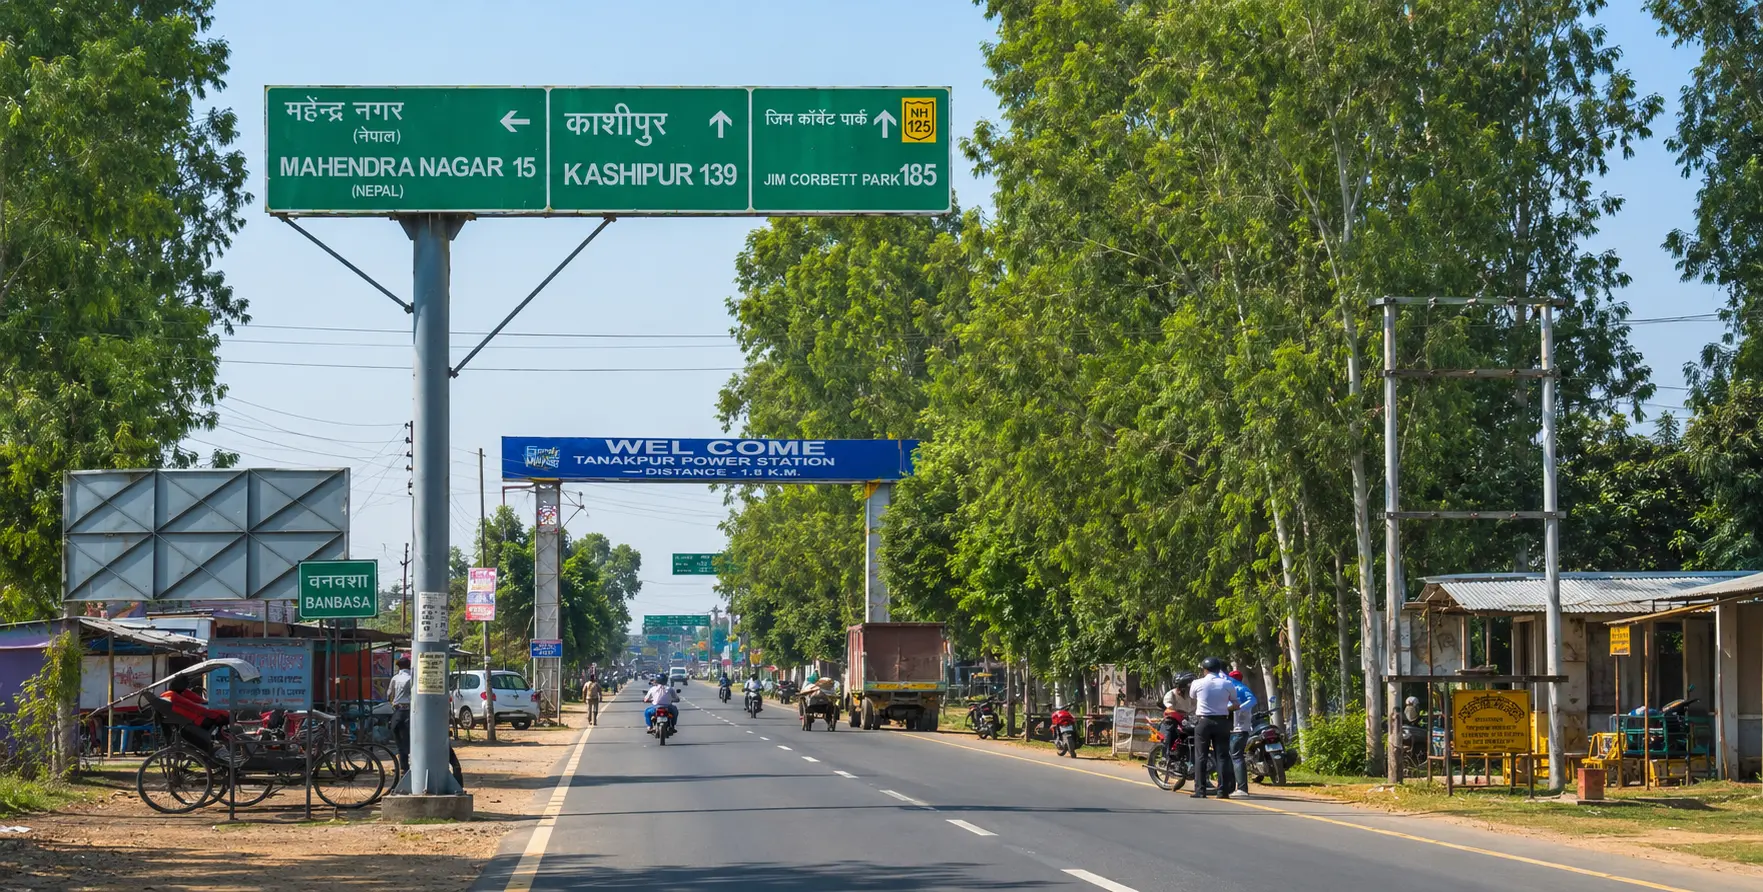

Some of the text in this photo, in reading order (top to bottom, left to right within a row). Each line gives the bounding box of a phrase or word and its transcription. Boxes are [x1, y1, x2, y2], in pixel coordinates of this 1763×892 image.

[352, 102, 405, 121] नगर
[765, 108, 794, 126] जिम
[839, 108, 868, 126] पार्क
[910, 107, 929, 118] NH
[564, 102, 669, 147] काशीपुर
[907, 120, 931, 133] 125
[353, 126, 401, 145] (नेपाल)
[280, 156, 537, 178] MAHENDRA NAGAR 15
[564, 163, 738, 186] KASHIPUR 139
[764, 163, 938, 187] JIM CORBETT PARK 185
[351, 184, 404, 199] (NEPAL)
[605, 439, 826, 456] WEL COME
[573, 455, 675, 466] TANAKPUR
[681, 456, 752, 467] POWER
[756, 457, 835, 467] STATION
[645, 468, 727, 476] DISTANCE
[767, 468, 801, 477] K.M.
[305, 595, 372, 610] BANBASA
